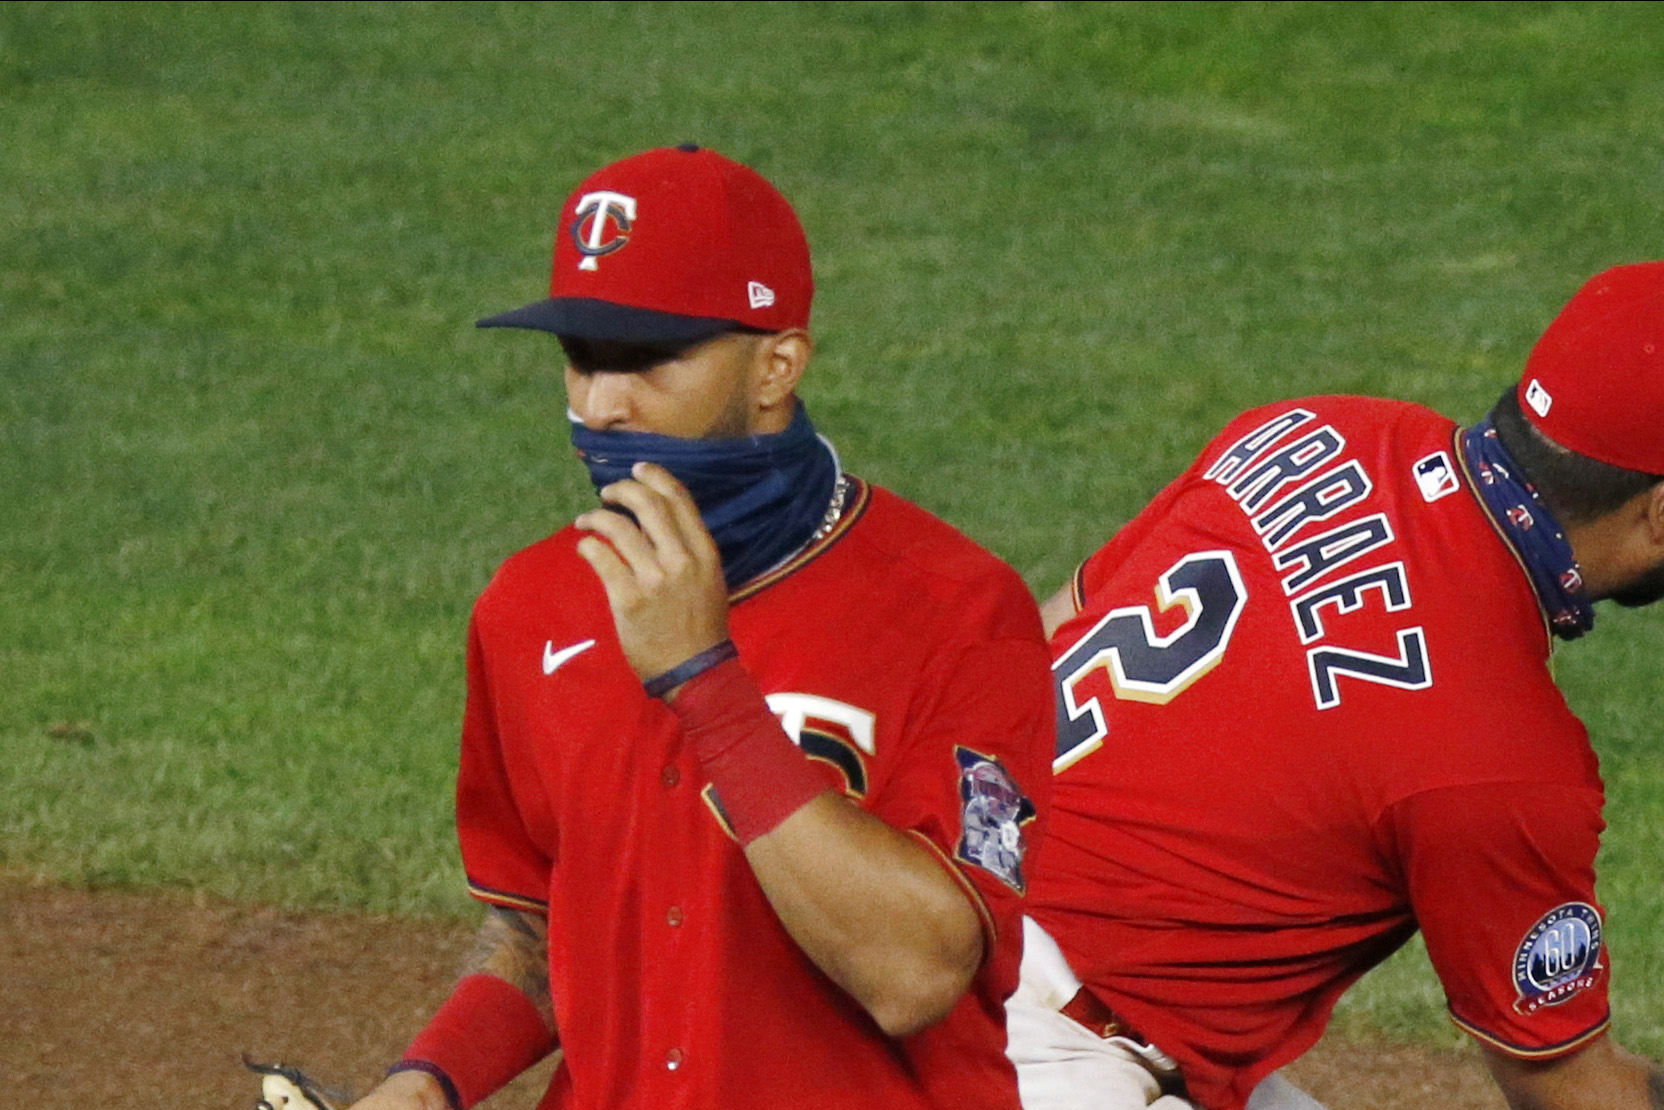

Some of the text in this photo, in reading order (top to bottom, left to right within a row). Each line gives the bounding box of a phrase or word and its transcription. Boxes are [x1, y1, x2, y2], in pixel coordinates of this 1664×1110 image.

[1203, 408, 1434, 711] ARRAEZ
[1052, 550, 1248, 776] 2
[1516, 907, 1600, 982] MINNESOTA TWINS
[1545, 922, 1576, 977] 60
[1528, 976, 1594, 1012] SEASONS
